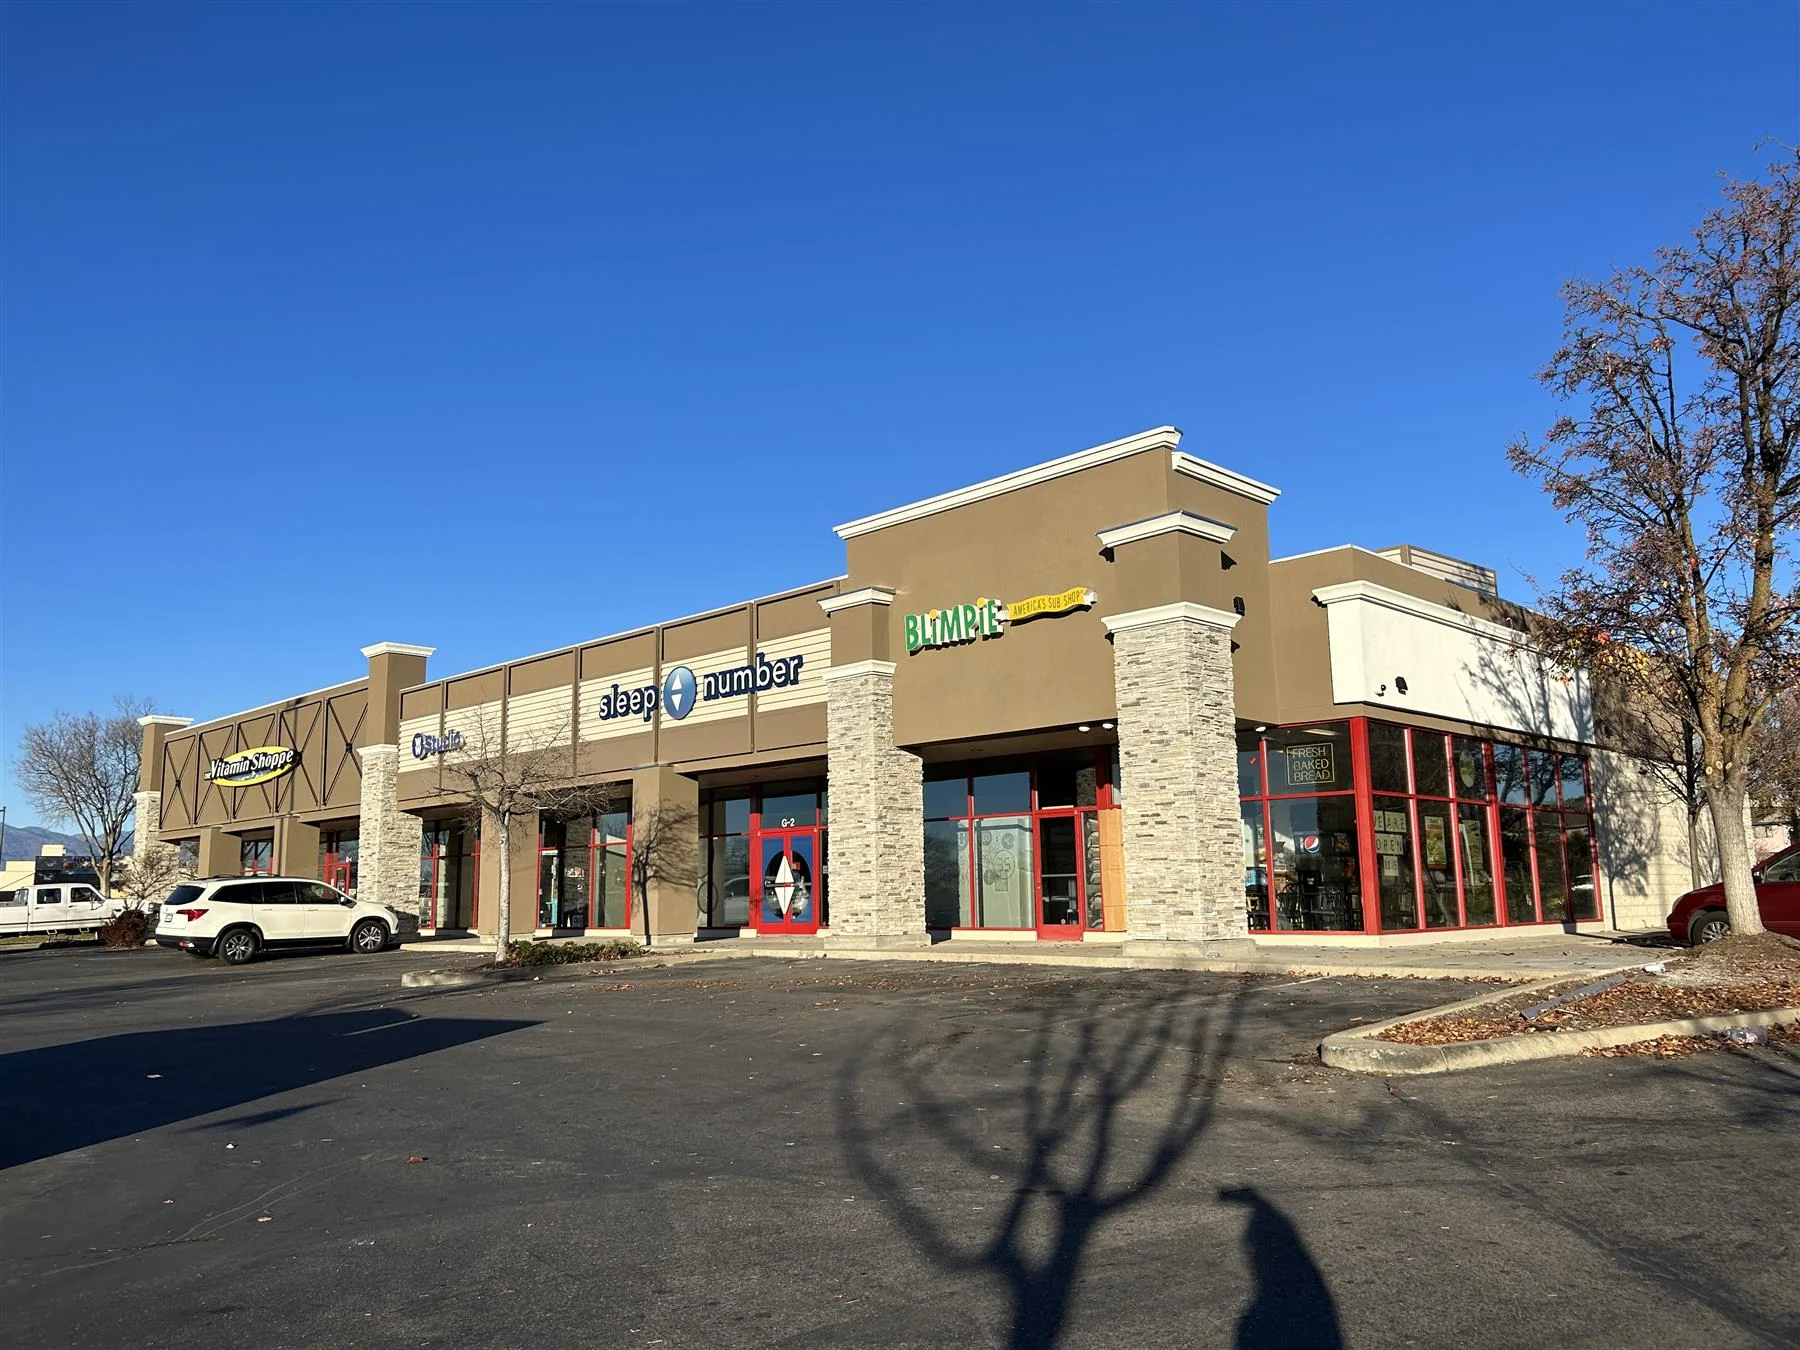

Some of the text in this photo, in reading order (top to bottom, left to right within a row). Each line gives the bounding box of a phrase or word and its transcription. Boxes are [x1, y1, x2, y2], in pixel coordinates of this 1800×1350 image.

[1048, 597, 1061, 609] SUB
[1063, 590, 1080, 607] SHOP
[599, 652, 803, 721] sleep number
[1292, 746, 1326, 758] FRESH
[211, 758, 250, 778] Vitamin
[250, 750, 294, 770] Shoppe
[1293, 758, 1329, 771] BAKED
[1294, 769, 1330, 782] BREAD
[781, 817, 795, 828] G-2
[1387, 817, 1405, 830] ARE
[1375, 838, 1402, 851] OPEN
